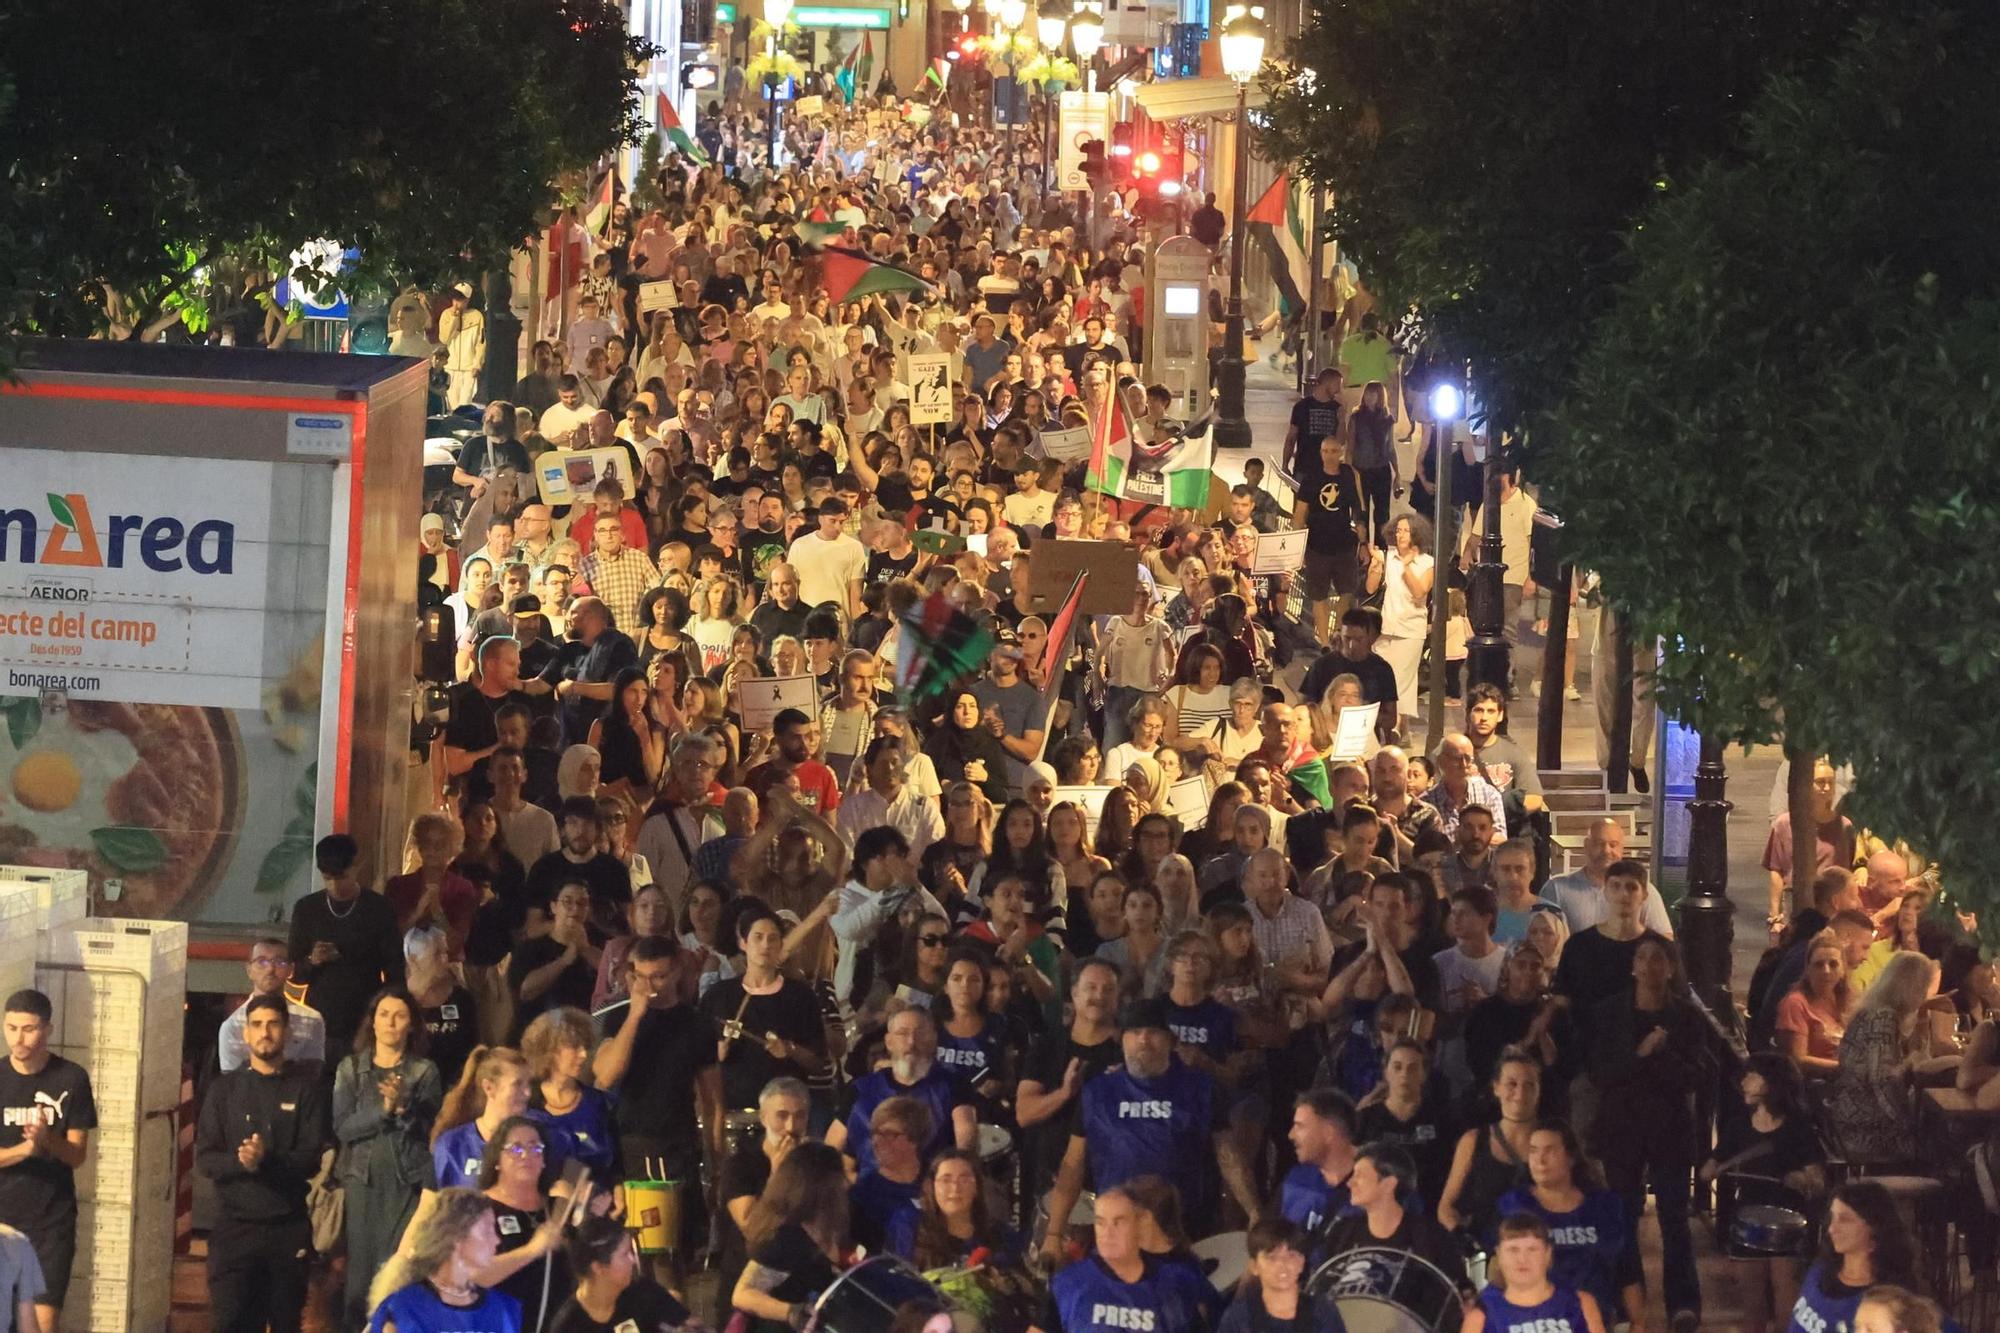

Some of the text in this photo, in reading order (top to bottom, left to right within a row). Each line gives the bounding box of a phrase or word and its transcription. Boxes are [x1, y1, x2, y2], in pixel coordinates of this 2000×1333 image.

[1127, 479, 1164, 496] PALESTINE
[30, 586, 89, 601] AENOR
[48, 610, 85, 638] del
[91, 618, 157, 647] camp
[9, 670, 100, 691] bonarea.com
[936, 1046, 985, 1068] PRESS
[1118, 1100, 1172, 1119] PRESS
[1092, 1303, 1155, 1331] PRESS
